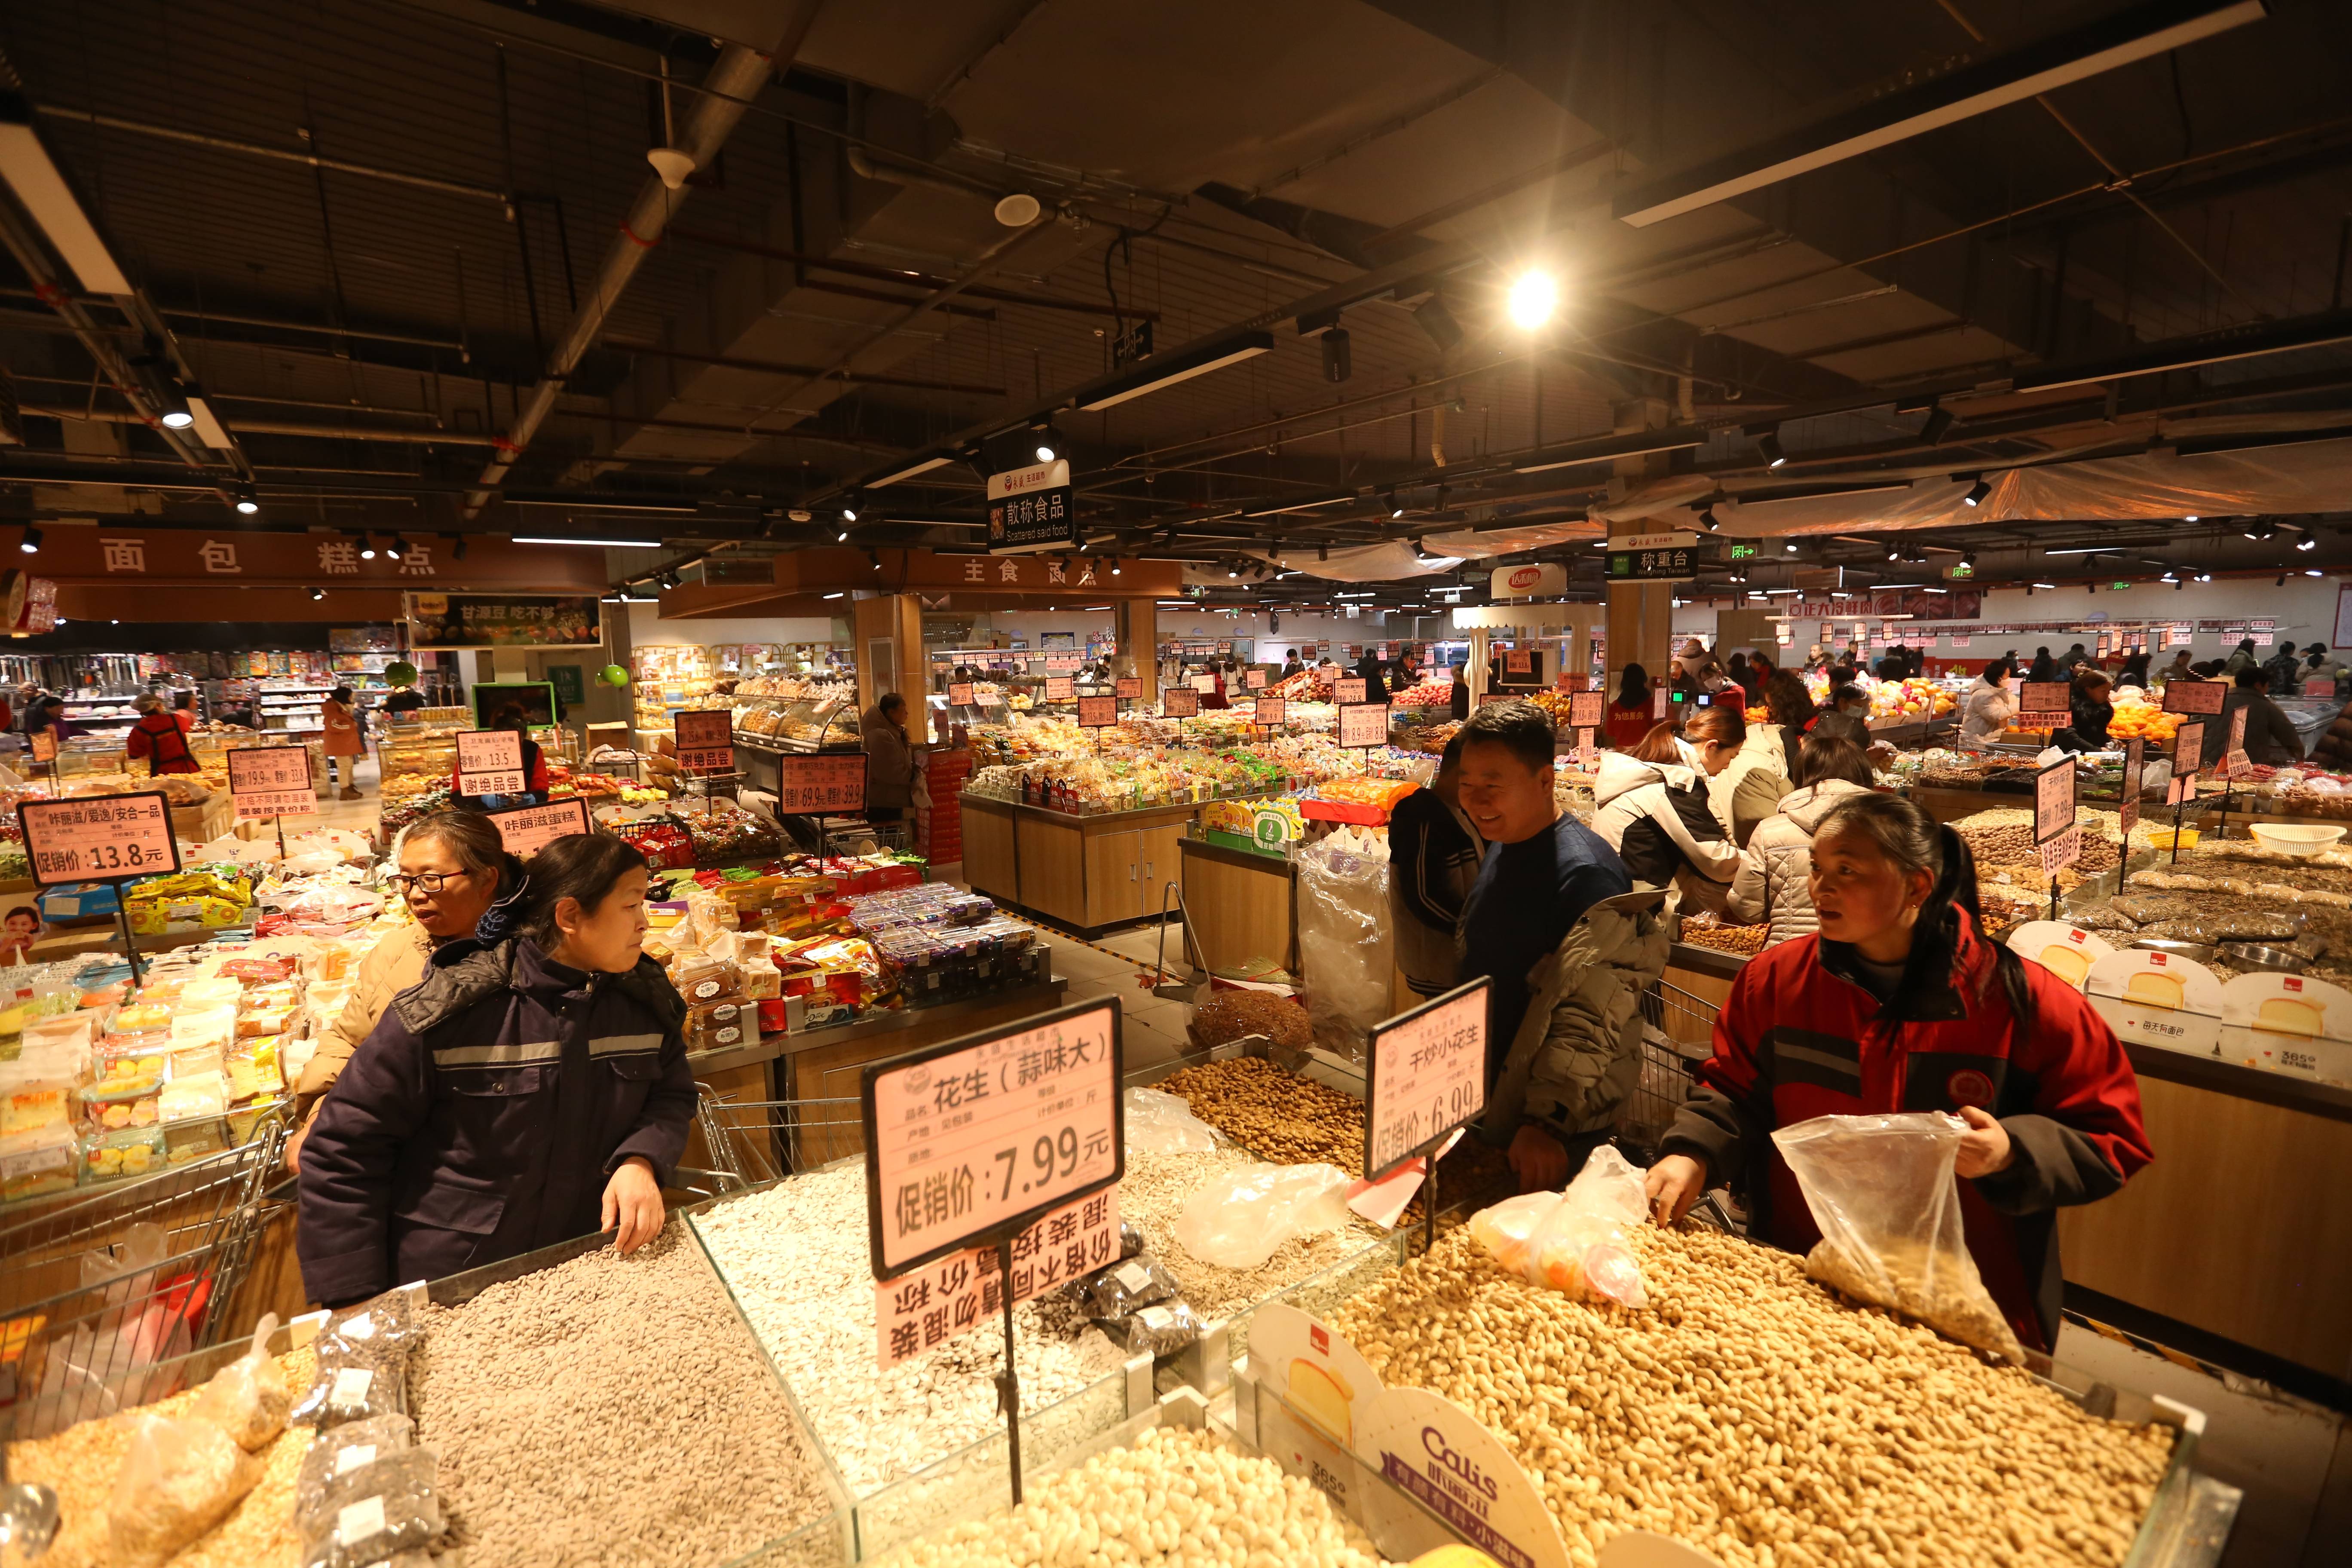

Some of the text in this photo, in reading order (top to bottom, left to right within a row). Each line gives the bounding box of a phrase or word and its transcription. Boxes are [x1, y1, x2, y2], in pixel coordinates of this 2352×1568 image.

[1007, 494, 1063, 526] 散称食品
[1007, 523, 1068, 542] Scattered said food
[1641, 551, 1687, 568] 称重台
[510, 606, 555, 619] 吃不够
[1805, 600, 1872, 616] 正大冷鲜肉
[1614, 712, 1644, 721] 为您服务
[681, 751, 728, 767] 谢绝品尝
[465, 775, 519, 793] 谢绝品尝
[2048, 770, 2070, 787] 干炒瓜子
[238, 793, 309, 805] 价格不同请勿混装
[239, 805, 310, 815] 混装按高价称
[505, 810, 577, 831] 咔丽滋蛋糕
[808, 1012, 825, 1022] Dove
[2143, 1020, 2184, 1037] 每天有面包
[1409, 1023, 1479, 1072] 干炒小花生
[1421, 1426, 1498, 1502] Calis
